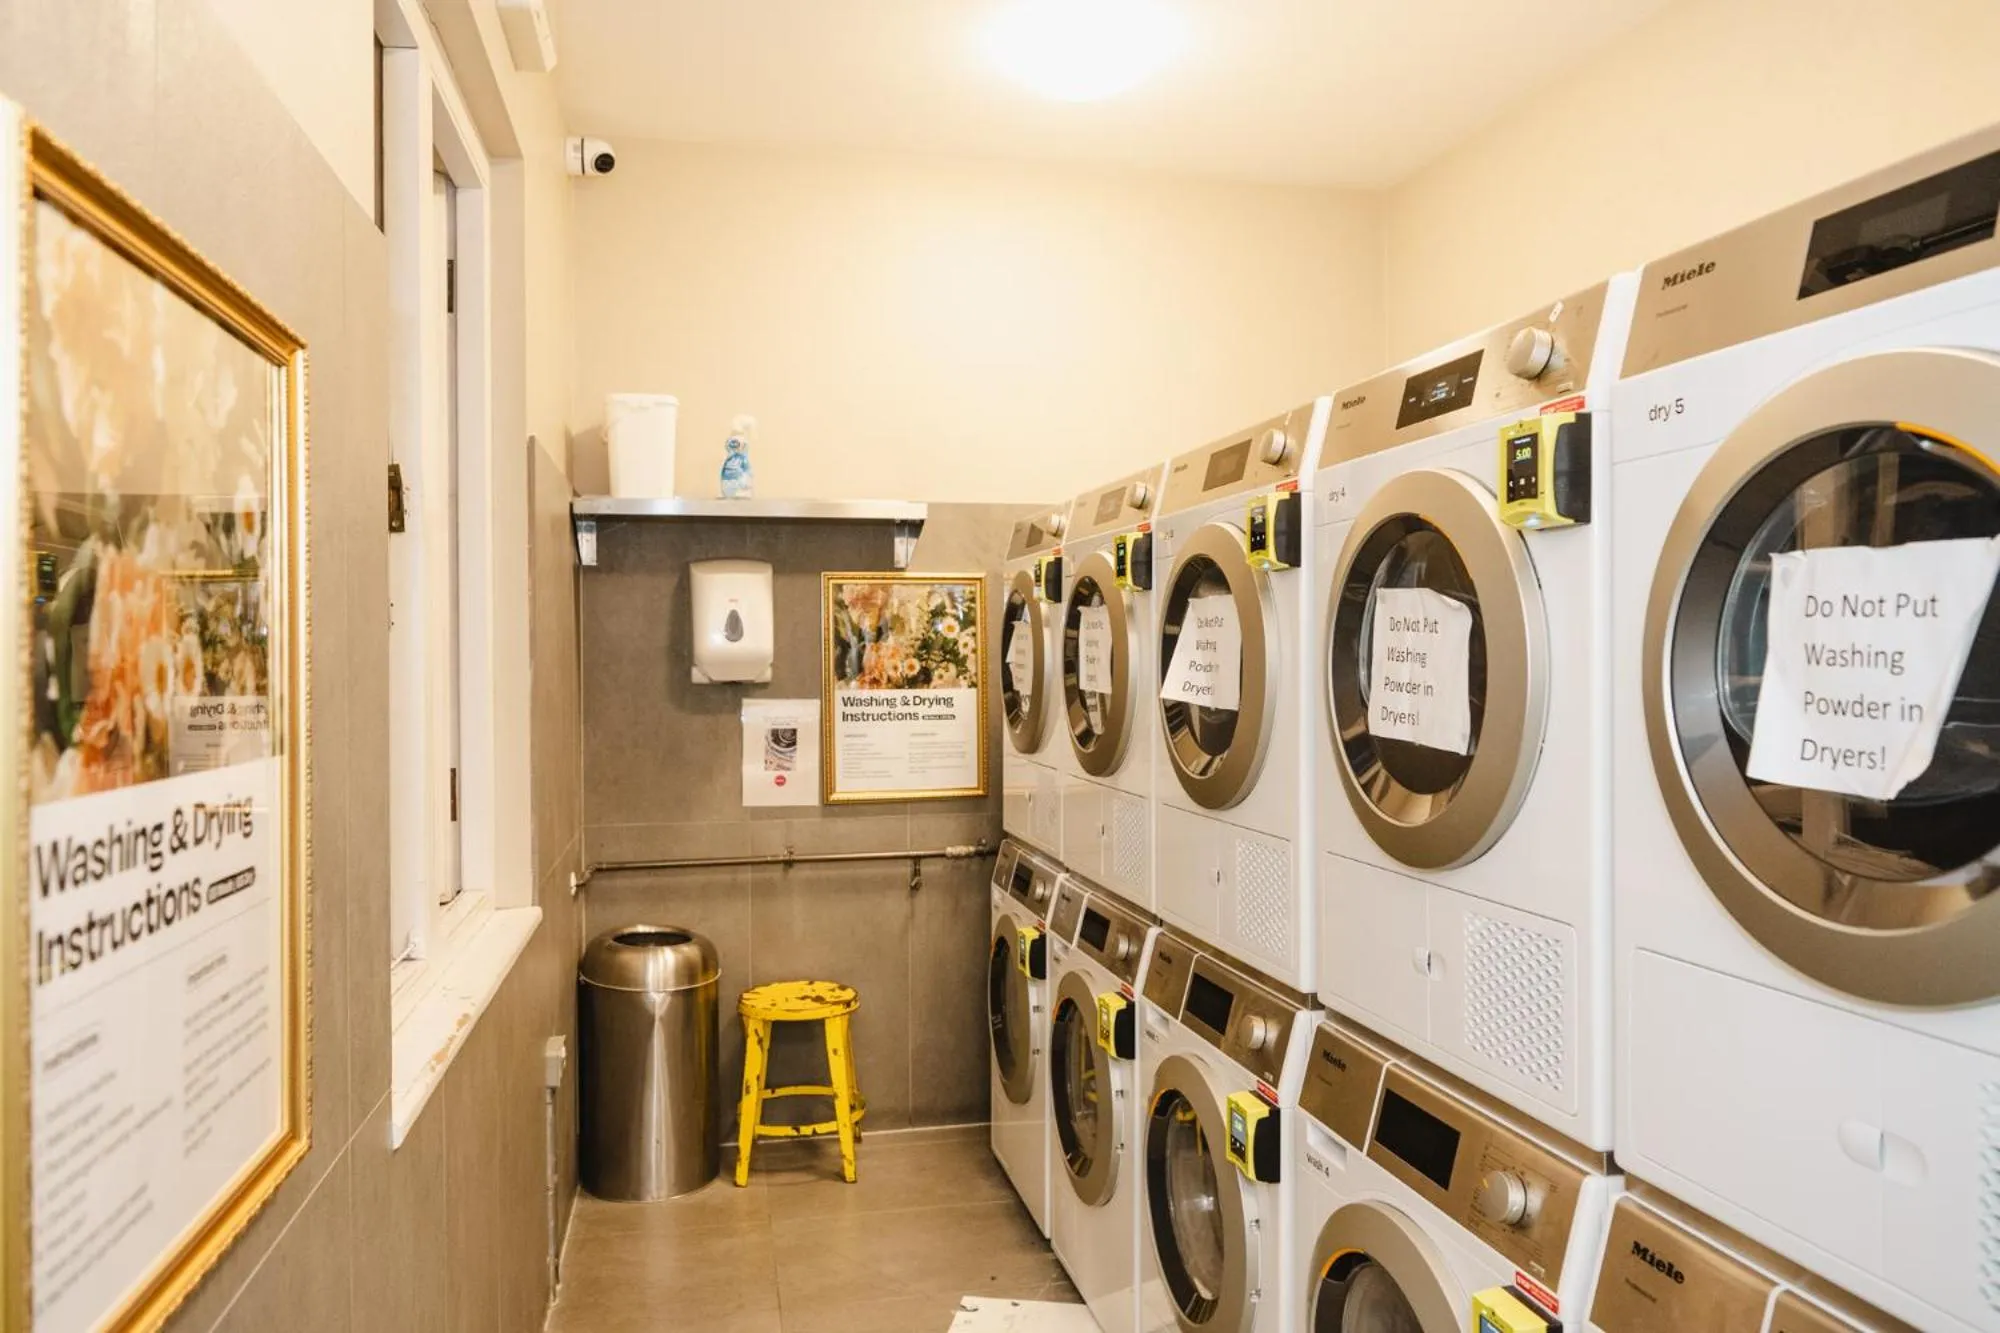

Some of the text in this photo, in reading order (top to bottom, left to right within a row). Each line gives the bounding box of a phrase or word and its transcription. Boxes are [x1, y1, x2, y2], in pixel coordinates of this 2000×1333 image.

[1661, 259, 1717, 291] Miele
[1648, 397, 1685, 422] dry 5
[1804, 592, 1940, 619] Do Not Put
[1389, 616, 1440, 634] Do Not Put
[1386, 646, 1429, 669] Washing
[1803, 643, 1906, 676] Washing
[1383, 676, 1434, 697] Powder in
[841, 695, 955, 709] Washing & Drying
[1803, 690, 1924, 723] Powder in
[841, 711, 920, 723] Instructions
[1380, 705, 1420, 727] Dryers!
[1799, 738, 1887, 771] Dryers!
[35, 820, 165, 899] Washing
[169, 810, 190, 852] &
[192, 793, 255, 850] Drying
[36, 876, 204, 988] Instructions
[1631, 1240, 1685, 1287] Miele
